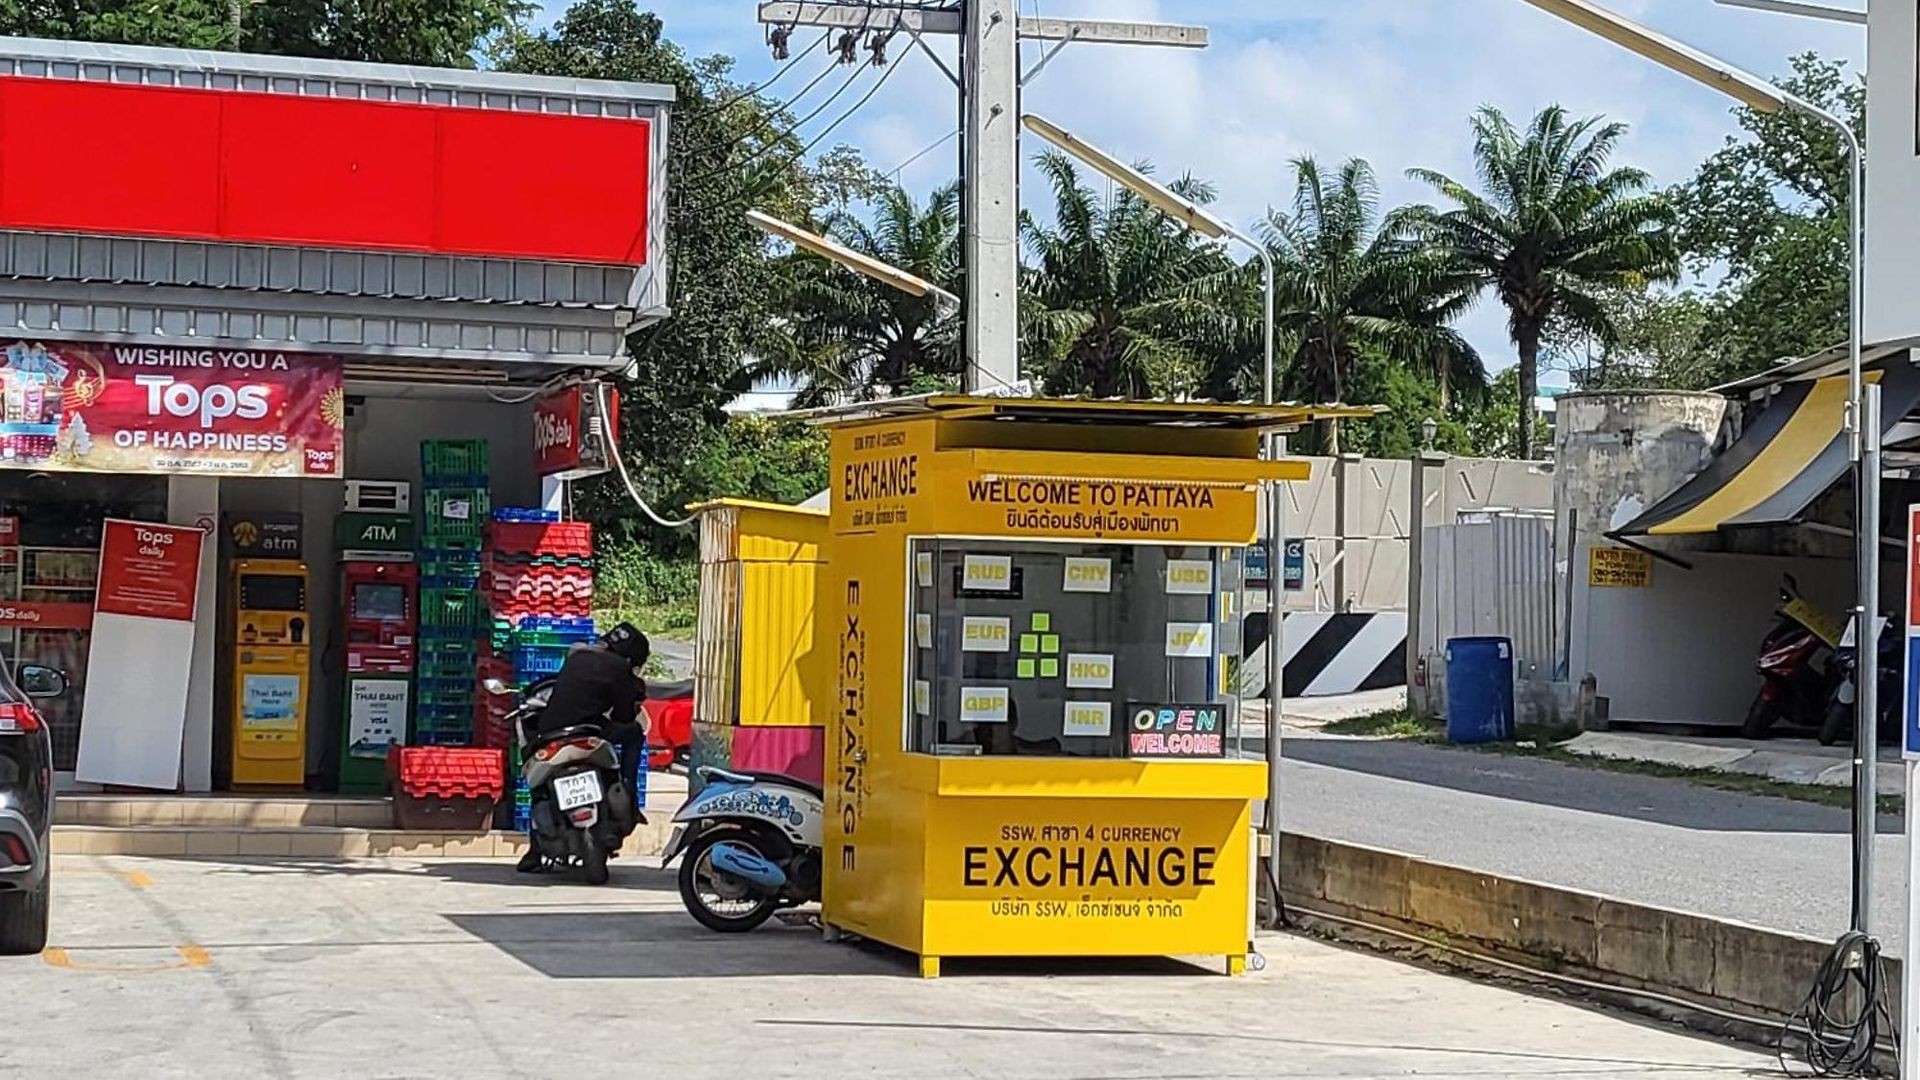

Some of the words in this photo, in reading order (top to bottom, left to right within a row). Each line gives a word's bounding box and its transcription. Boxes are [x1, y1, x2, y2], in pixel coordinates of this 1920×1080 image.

[115, 348, 213, 368] WISHING
[218, 352, 264, 370] YOU
[271, 354, 289, 371] A
[135, 374, 268, 428] Tops
[114, 431, 146, 449] OF
[152, 432, 288, 452] HAPPINESS
[305, 448, 335, 463] Tops
[845, 455, 918, 502] EXCHANGE
[968, 480, 1080, 505] WELCOME
[1088, 484, 1117, 505] TO
[1122, 485, 1214, 508] PATTAYA
[134, 527, 174, 546] Tops
[361, 525, 397, 541] ATM
[139, 545, 165, 558] daily
[262, 537, 297, 550] atm
[967, 563, 1007, 581] RUB
[1066, 565, 1107, 581] CNY
[1169, 568, 1208, 584] USD
[965, 624, 1006, 641] EUR
[1170, 633, 1206, 647] JPY
[1070, 662, 1109, 679] HKD
[963, 695, 1004, 711] GBP
[842, 580, 860, 871] EXCHANGE
[1071, 709, 1104, 725] INR
[1134, 709, 1217, 731] OPEN
[1131, 733, 1221, 754] WELCOME
[1001, 825, 1038, 841] SSW.
[1041, 824, 1079, 841] สาขา
[1085, 824, 1095, 841] 4
[1101, 827, 1181, 842] CURRENCY
[964, 847, 1216, 887] EXCHANGE
[991, 896, 1029, 916] บริษัท
[1035, 901, 1071, 918] SSW.
[1146, 896, 1182, 917] จำกัด
